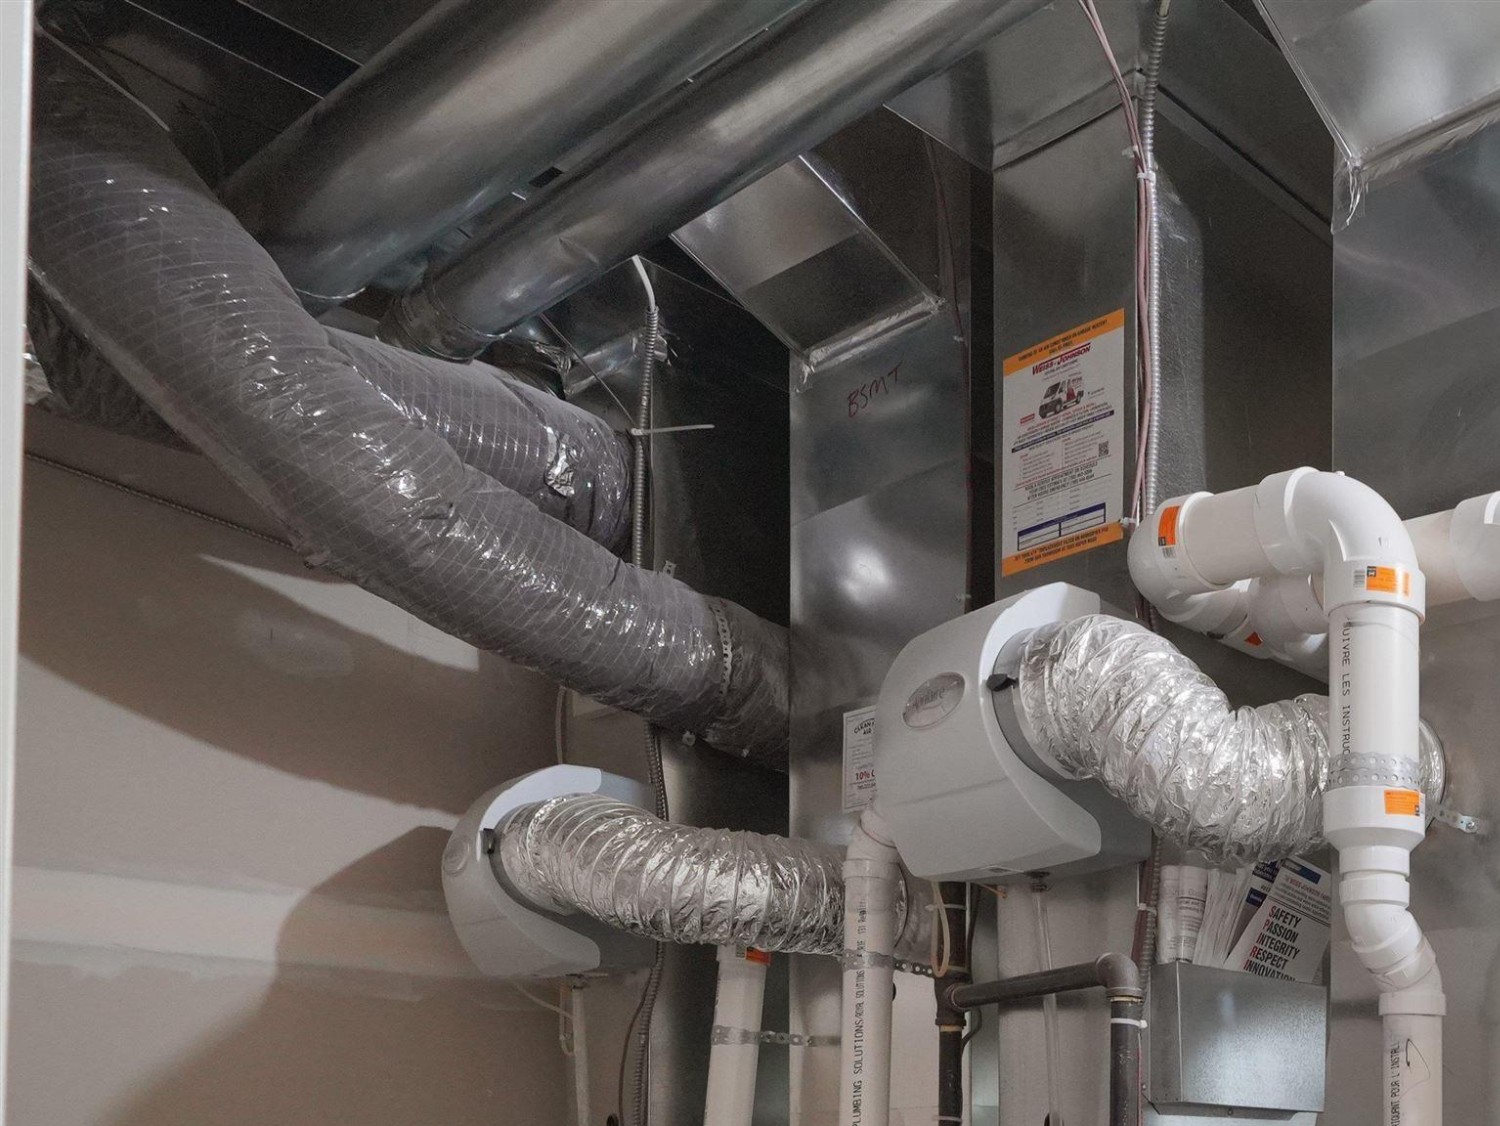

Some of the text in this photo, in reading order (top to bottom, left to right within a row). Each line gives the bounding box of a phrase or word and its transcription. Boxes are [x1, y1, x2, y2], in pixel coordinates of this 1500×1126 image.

[847, 361, 903, 418] BSMT
[1341, 673, 1350, 697] LES
[1341, 705, 1351, 756] INSTRUC
[855, 770, 870, 781] 10%
[1268, 906, 1301, 928] SAFETY
[1263, 921, 1299, 943] PASSION
[1250, 946, 1288, 970] RESPECT
[1256, 932, 1300, 960] INTEGRITY
